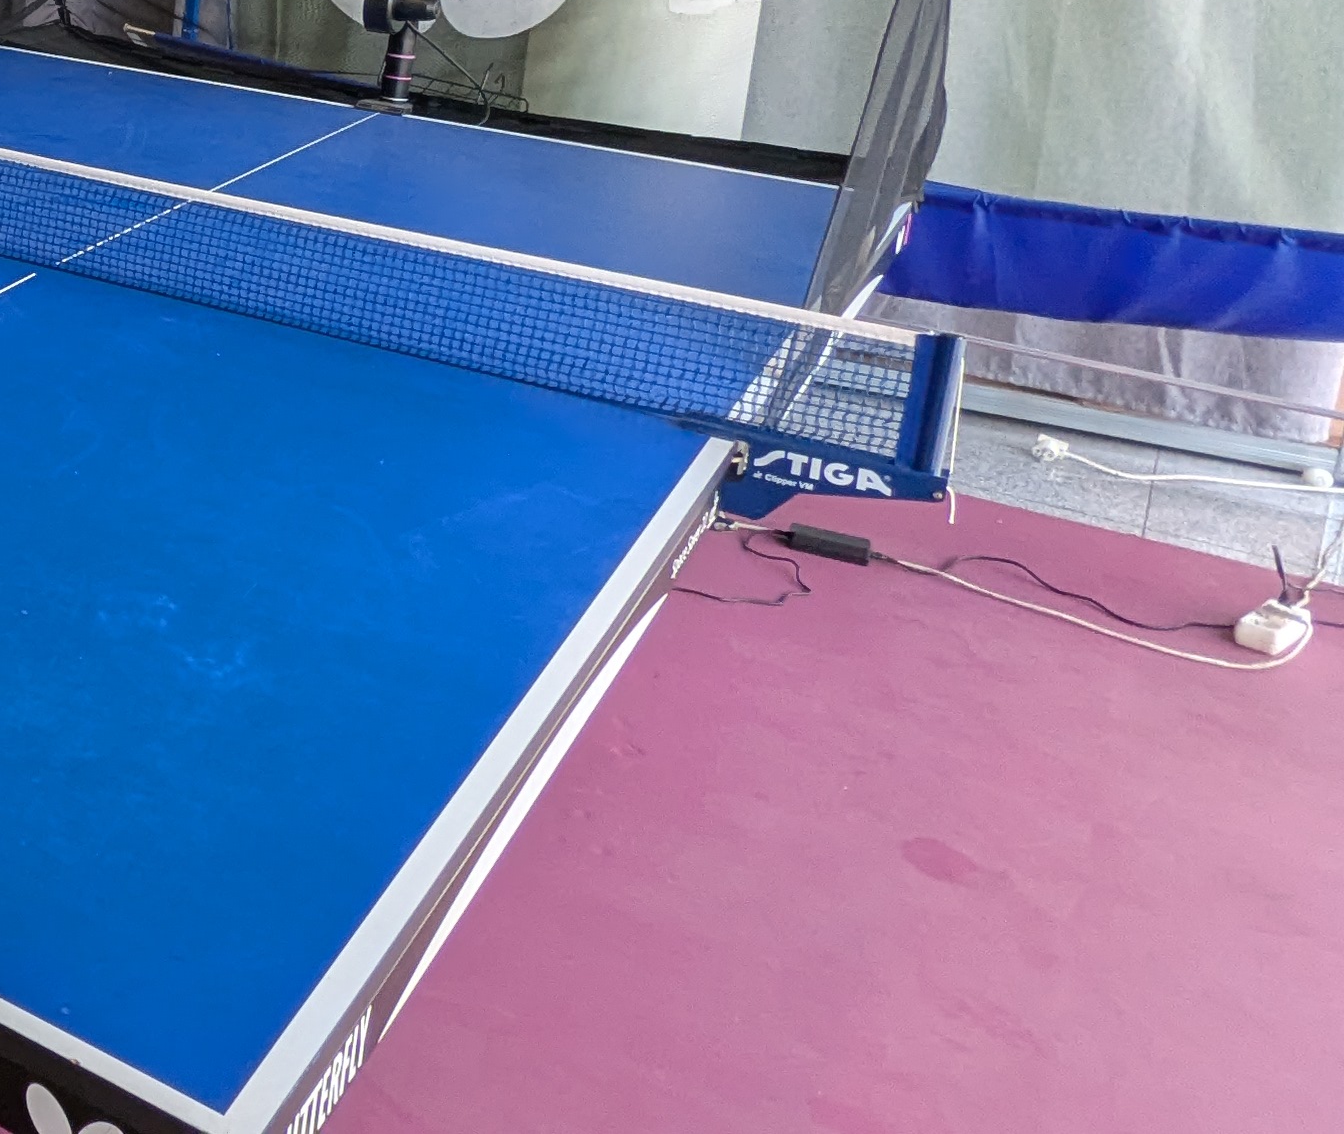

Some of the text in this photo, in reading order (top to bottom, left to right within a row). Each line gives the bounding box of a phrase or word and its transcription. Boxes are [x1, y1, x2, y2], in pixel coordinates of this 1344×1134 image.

[754, 450, 892, 497] STIGA
[765, 473, 798, 487] Clipper
[286, 1004, 372, 1134] TTERFLY
